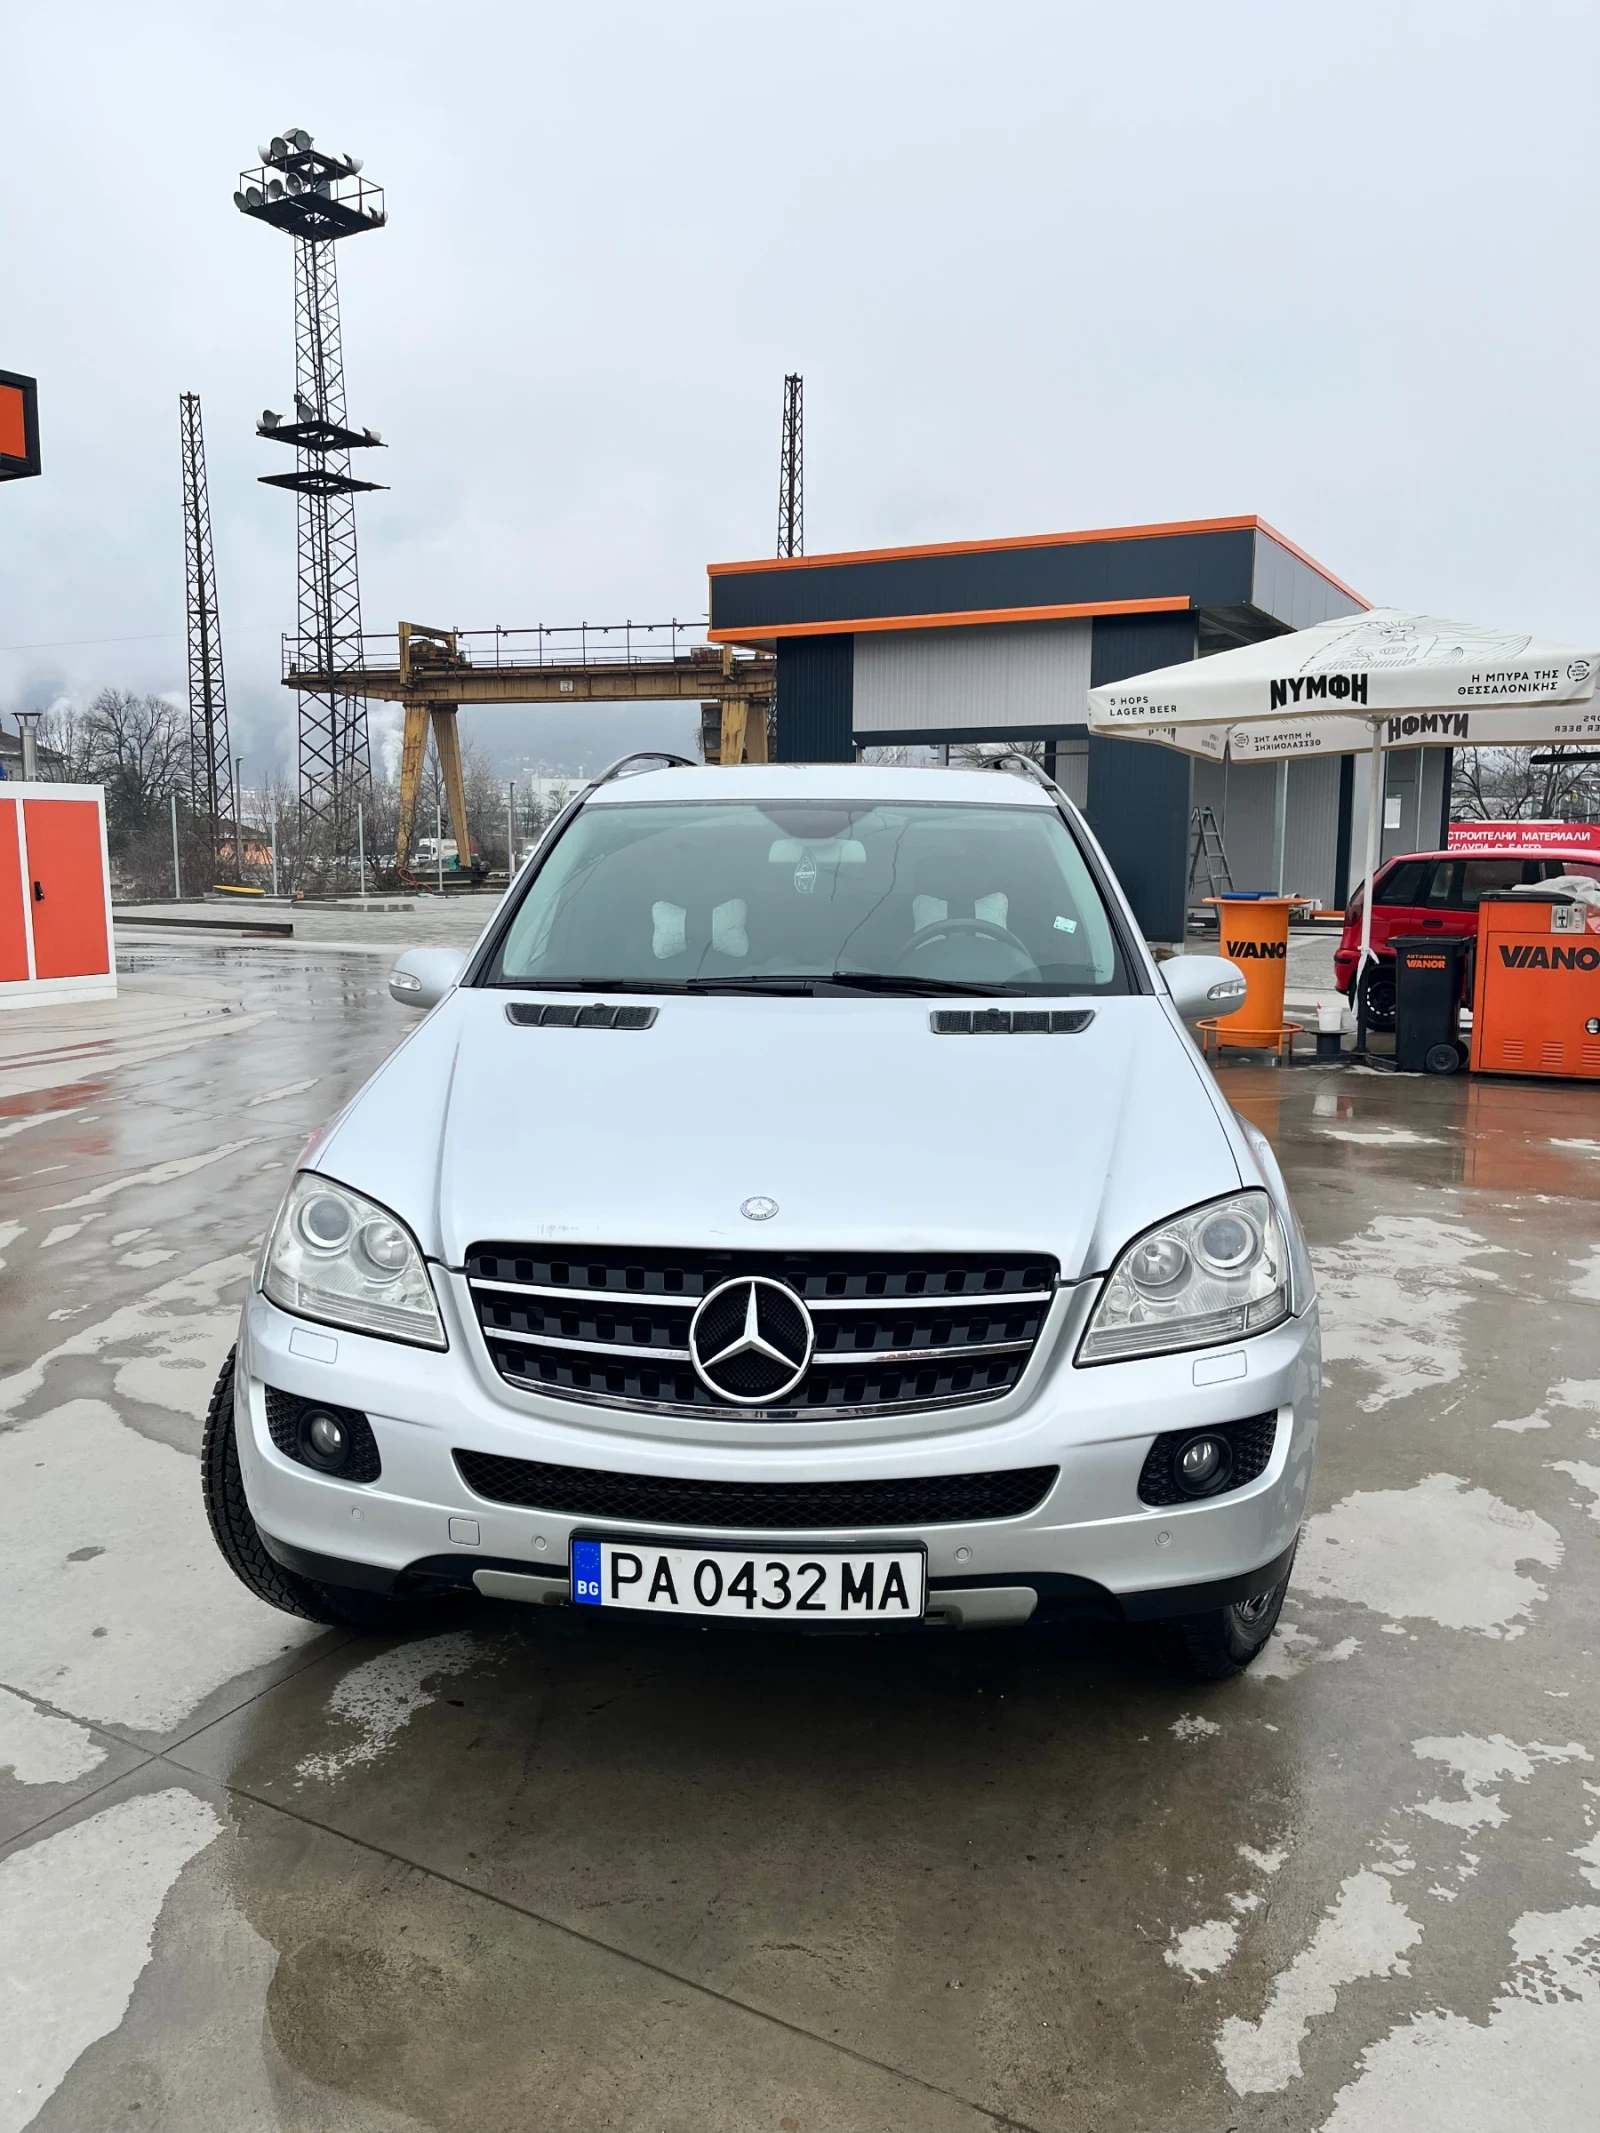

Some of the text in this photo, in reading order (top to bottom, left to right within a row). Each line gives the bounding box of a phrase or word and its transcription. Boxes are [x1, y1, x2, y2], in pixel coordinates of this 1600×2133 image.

[1486, 671, 1529, 682] ΜΠΥΡΑ
[1535, 669, 1559, 680] ΤΗΣ
[1270, 673, 1368, 711] ΝΥΜΦΗ
[1458, 681, 1558, 696] ΘΕΣΣΑΛΟΝΙΚΗΣ
[1110, 695, 1149, 706] 5 HOPS
[1109, 704, 1177, 716] LAGER BEER
[1448, 831, 1591, 842] СТРОИТЕЛНИ МАТЕРИАЛИ
[1226, 940, 1287, 959] VIANO
[577, 1580, 599, 1596] BG
[611, 1551, 910, 1612] PA 0432 MA
